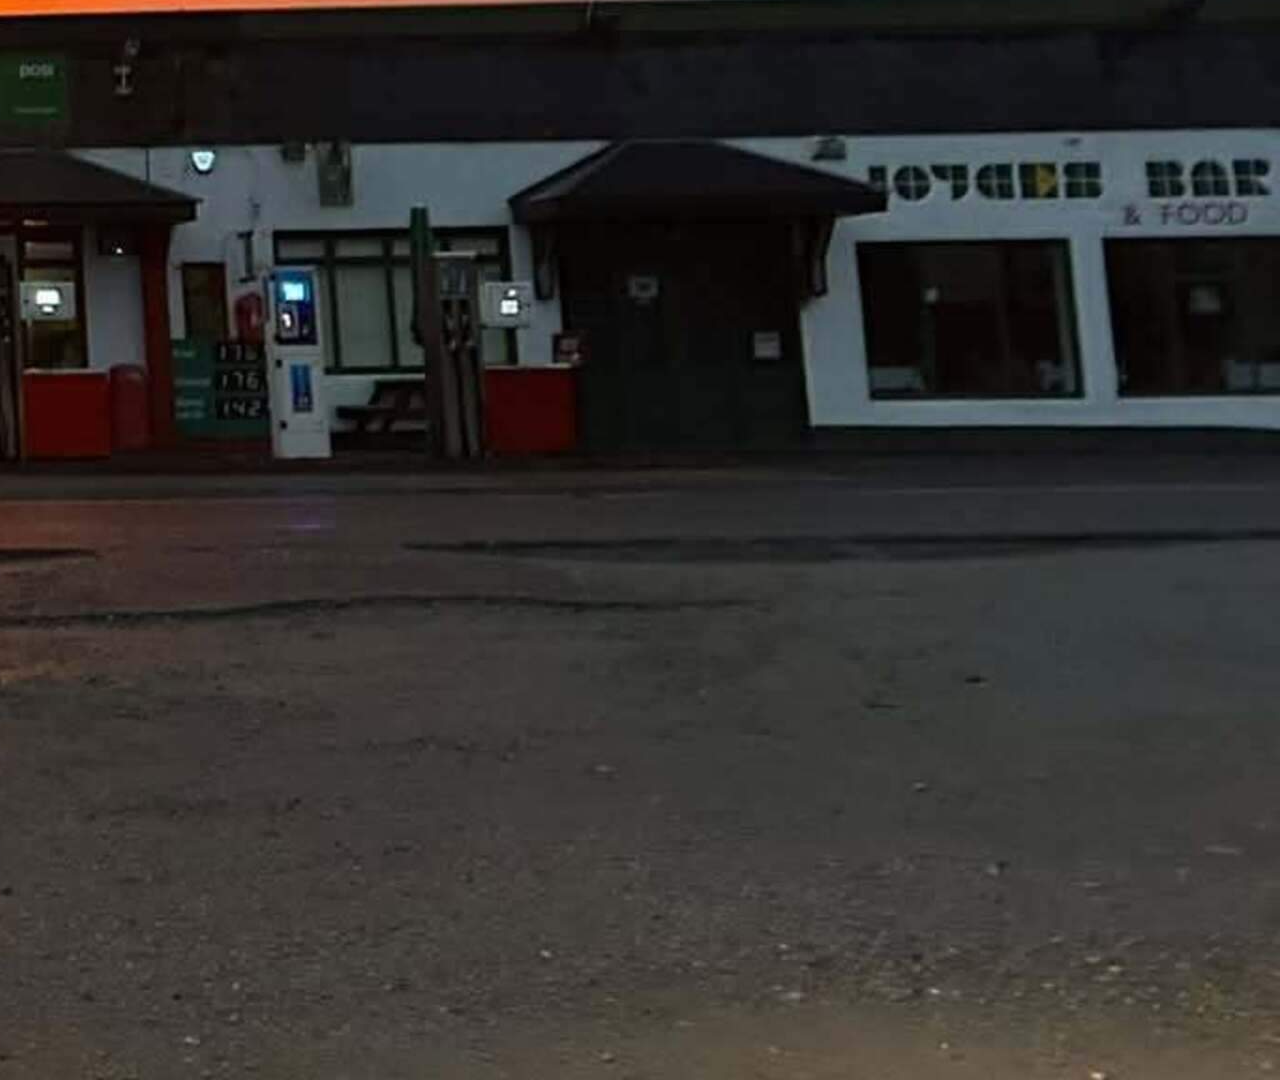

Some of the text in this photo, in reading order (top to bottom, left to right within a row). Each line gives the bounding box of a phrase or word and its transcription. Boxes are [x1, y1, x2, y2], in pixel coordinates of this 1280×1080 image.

[1146, 158, 1272, 198] BAR
[1121, 204, 1249, 227] & FOOD
